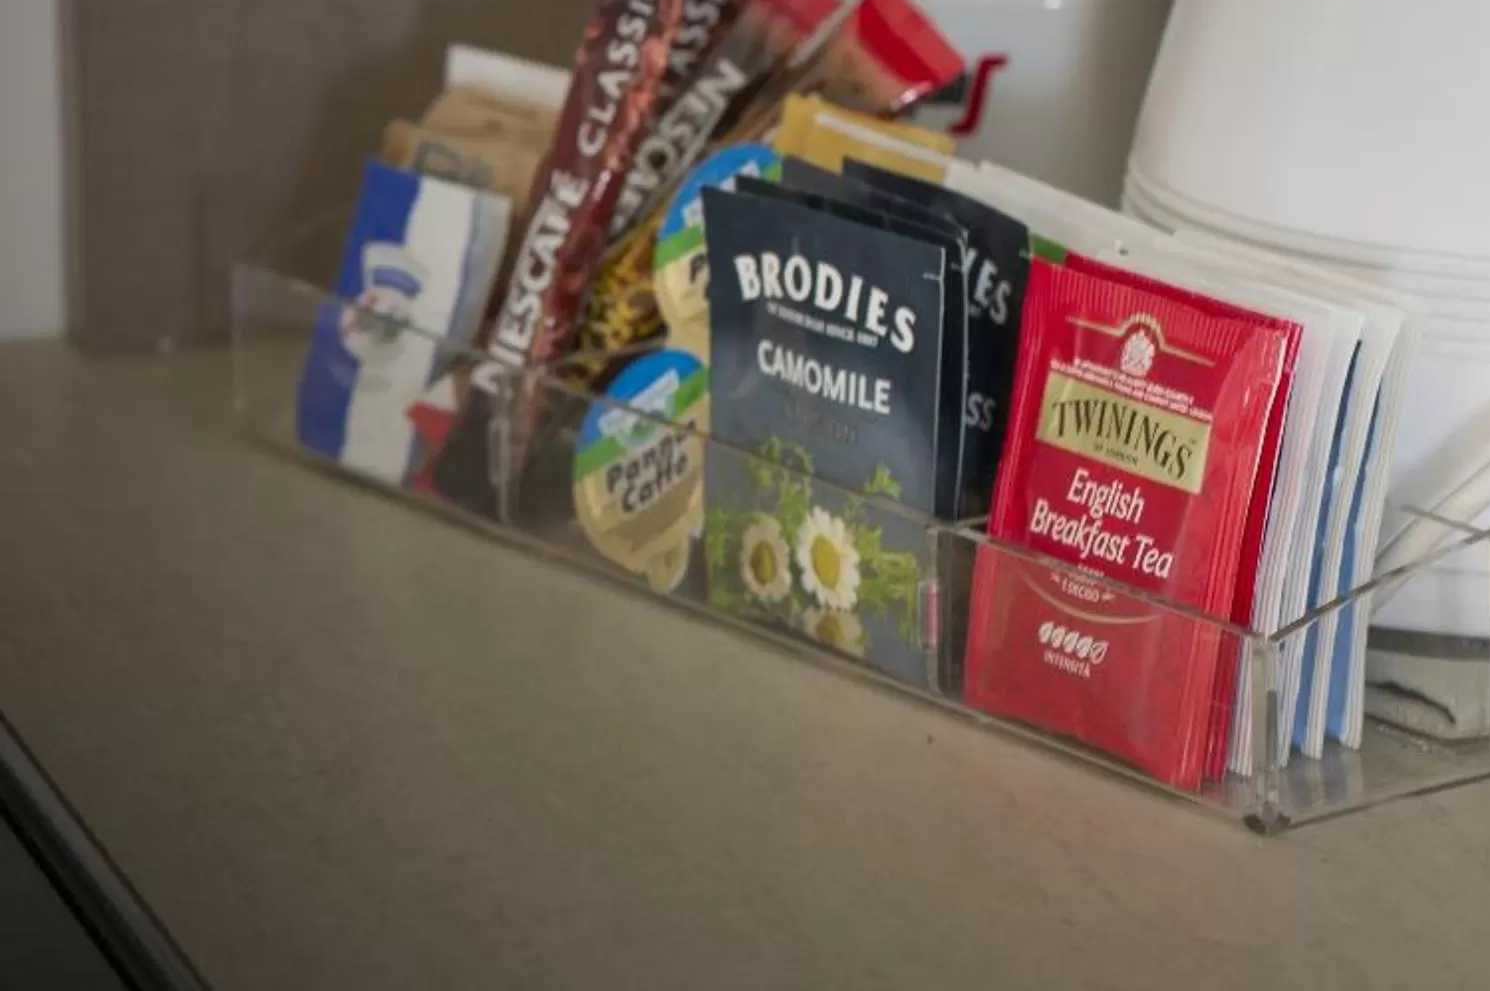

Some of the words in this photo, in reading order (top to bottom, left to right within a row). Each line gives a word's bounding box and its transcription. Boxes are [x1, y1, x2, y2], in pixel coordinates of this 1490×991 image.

[734, 251, 916, 353] BRODIES
[757, 339, 892, 415] CAMOMILE
[1052, 398, 1192, 479] TWININGS
[1067, 468, 1145, 523] English
[1031, 498, 1130, 564] Breakfast
[1133, 533, 1174, 578] Tea
